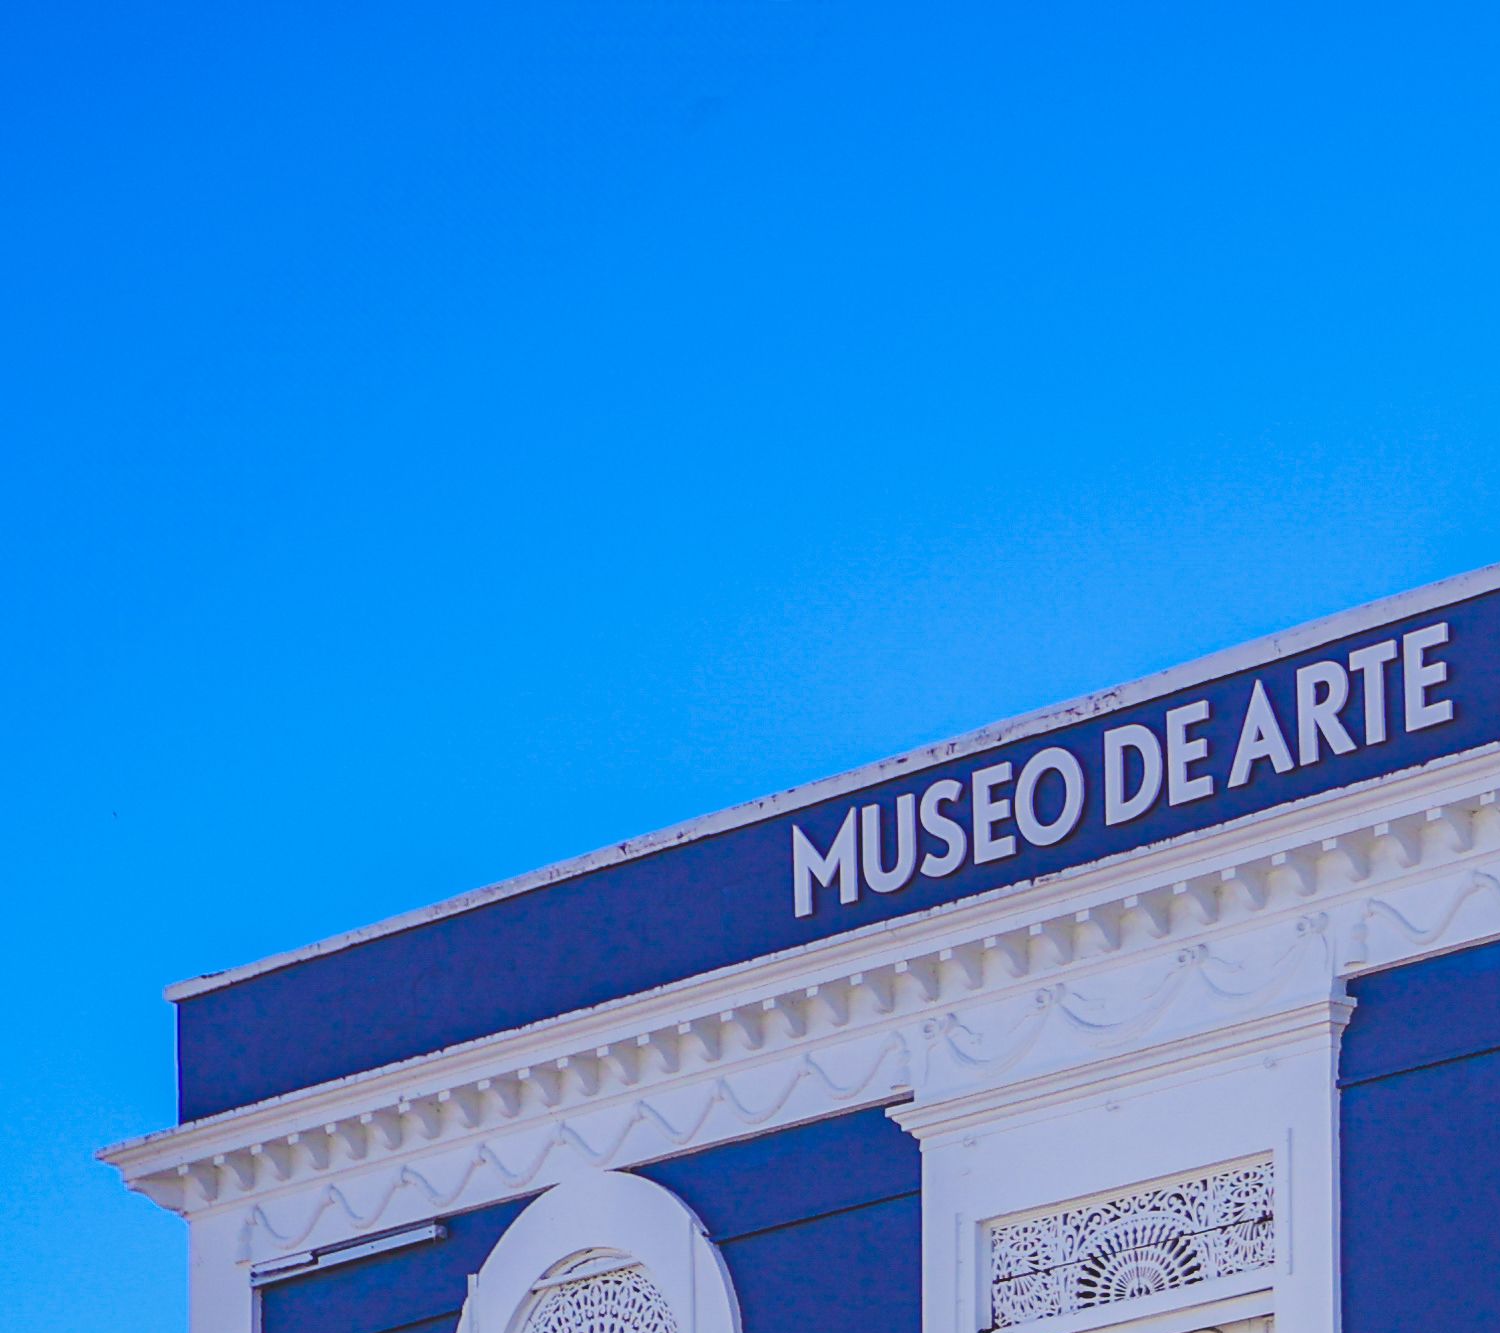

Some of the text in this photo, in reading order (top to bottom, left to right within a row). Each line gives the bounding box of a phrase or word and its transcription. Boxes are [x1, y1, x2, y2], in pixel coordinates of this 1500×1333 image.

[791, 621, 1454, 918] MUSEO DE ARTE
